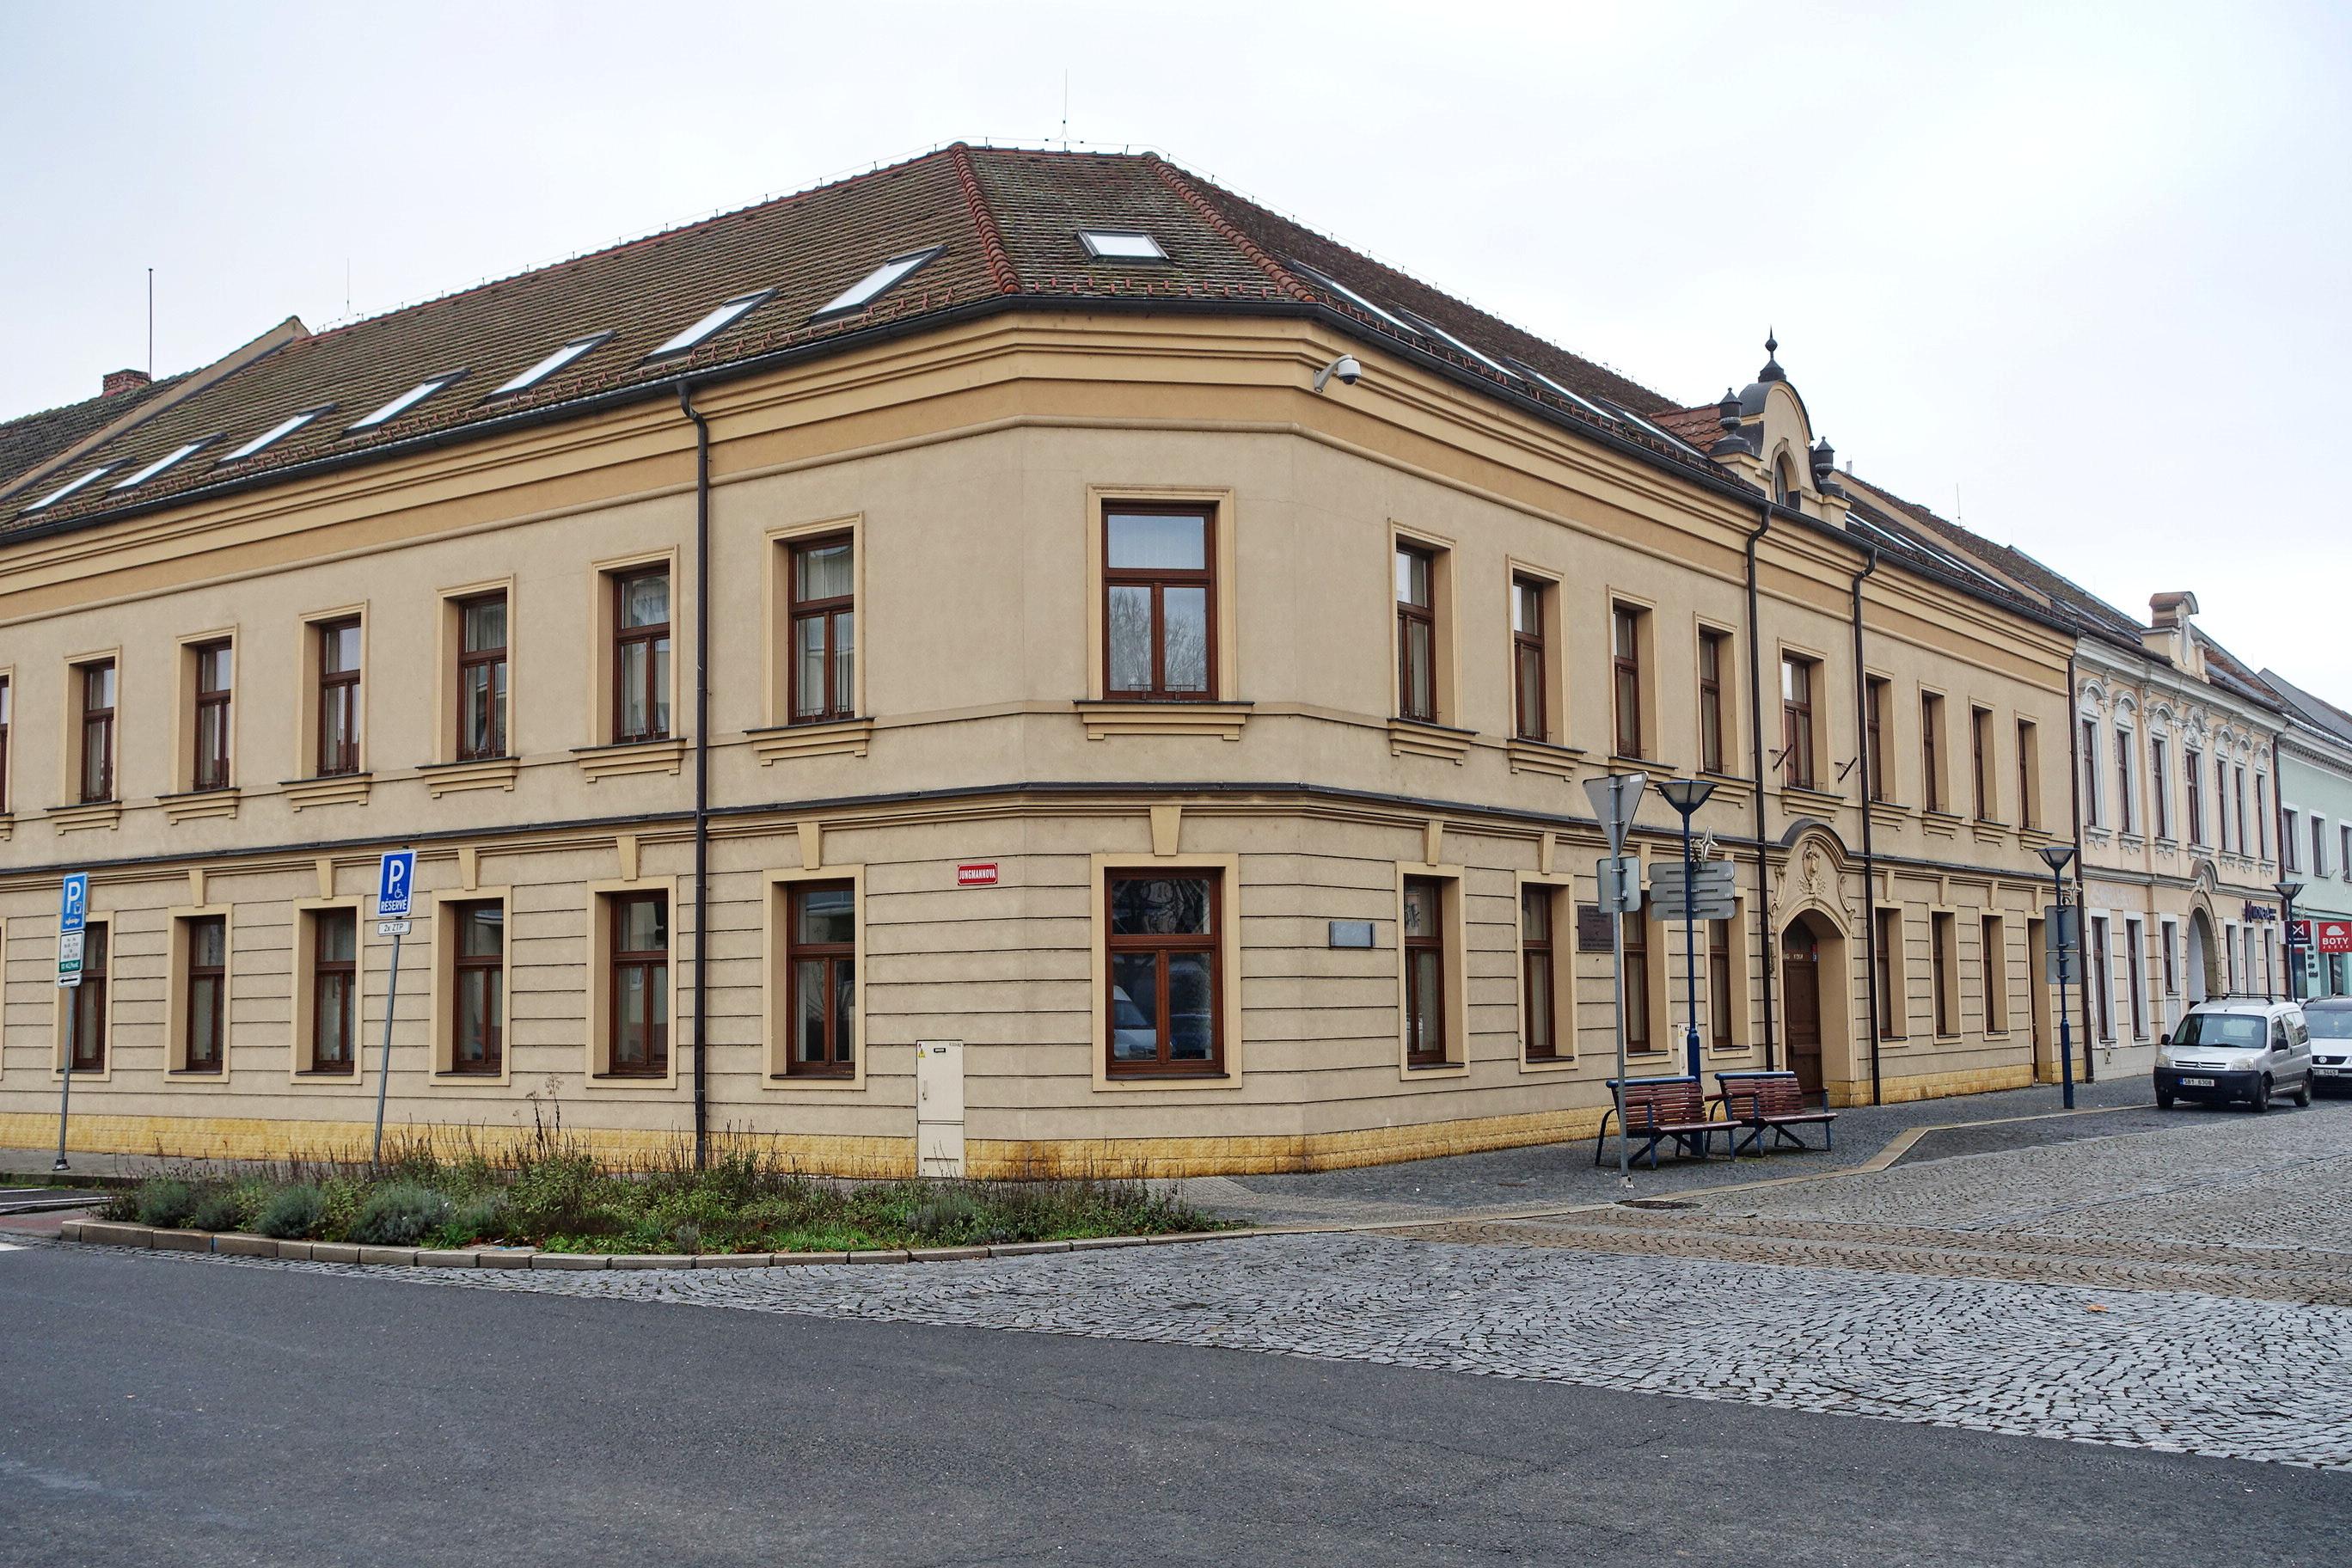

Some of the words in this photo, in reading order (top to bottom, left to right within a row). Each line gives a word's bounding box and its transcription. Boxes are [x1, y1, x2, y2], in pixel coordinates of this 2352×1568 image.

[388, 860, 405, 895] P
[959, 868, 995, 880] JUNGMANNOVA
[67, 881, 82, 914] P
[392, 922, 404, 931] ZTP
